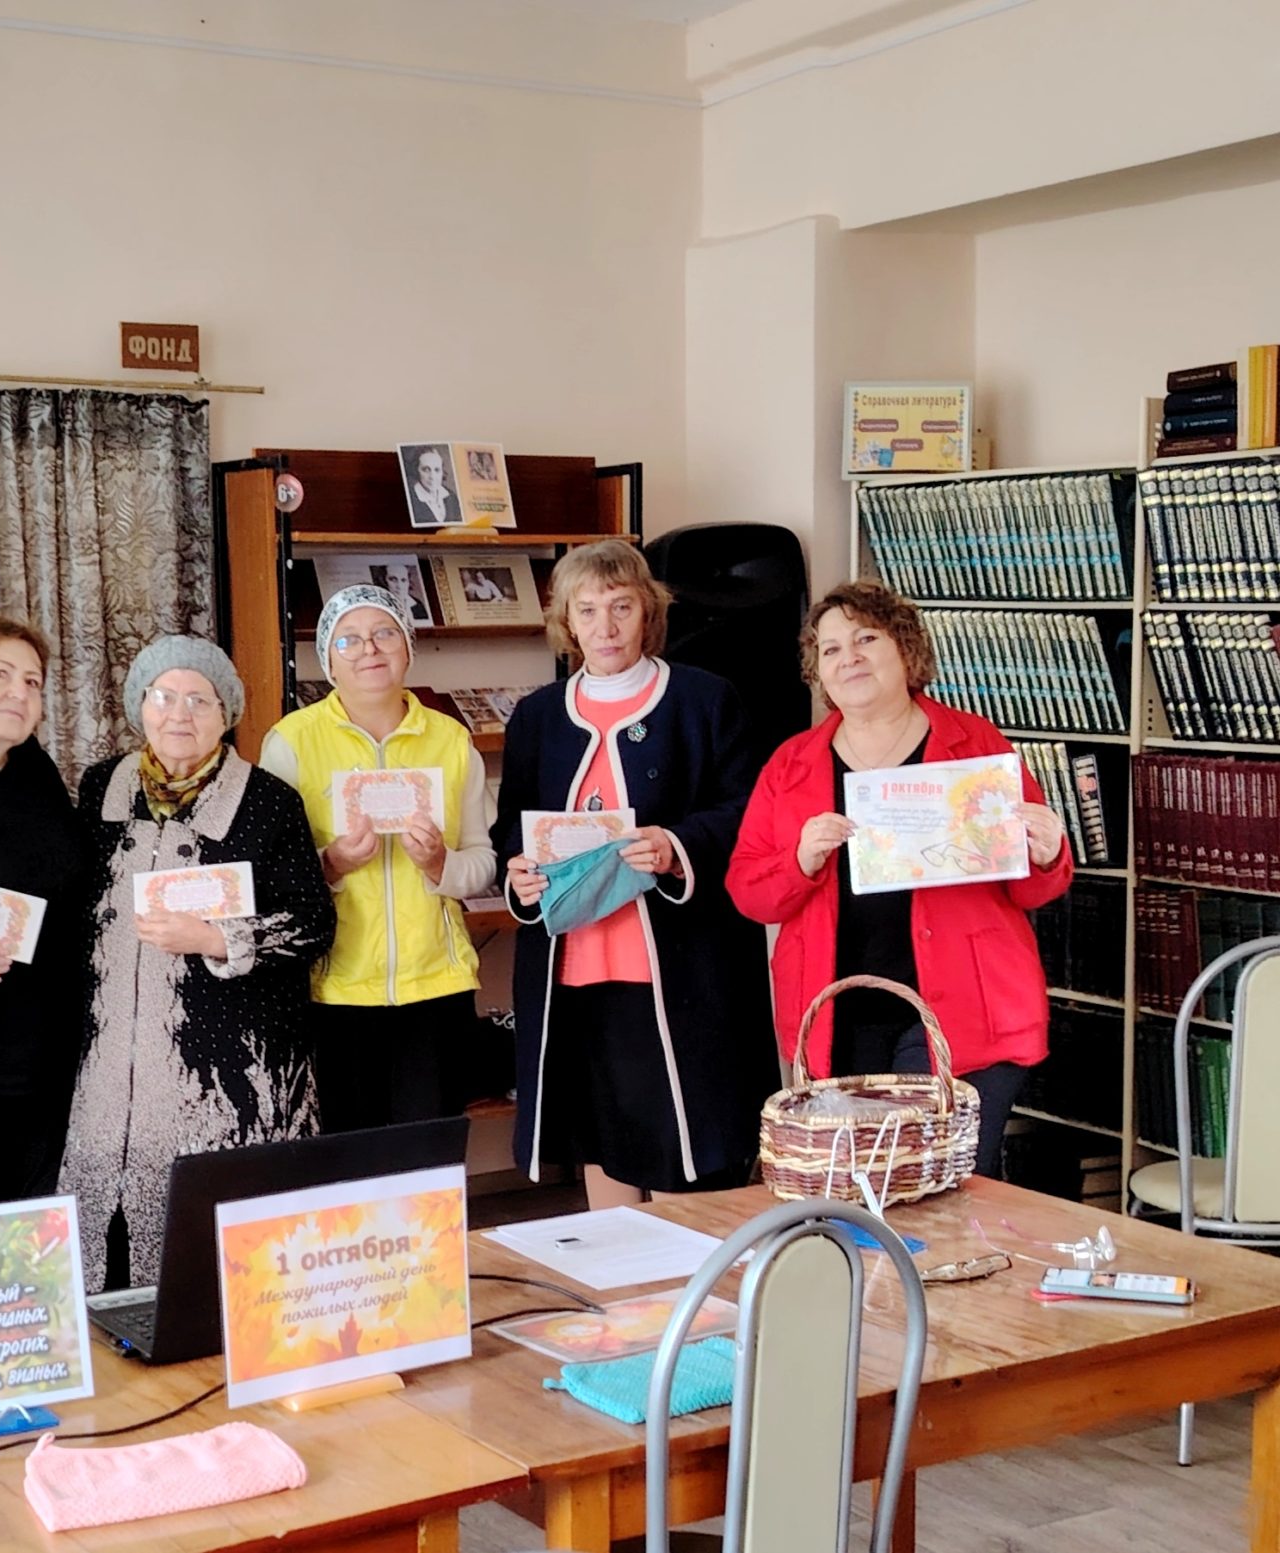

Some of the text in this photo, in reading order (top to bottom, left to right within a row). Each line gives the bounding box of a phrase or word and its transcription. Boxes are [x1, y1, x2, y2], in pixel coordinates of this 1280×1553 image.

[128, 335, 194, 363] ФОНД
[277, 483, 298, 503] 6+
[275, 1234, 412, 1277] 1 октября
[254, 1263, 438, 1307] Международный день
[280, 1286, 410, 1326] пожилых людей
